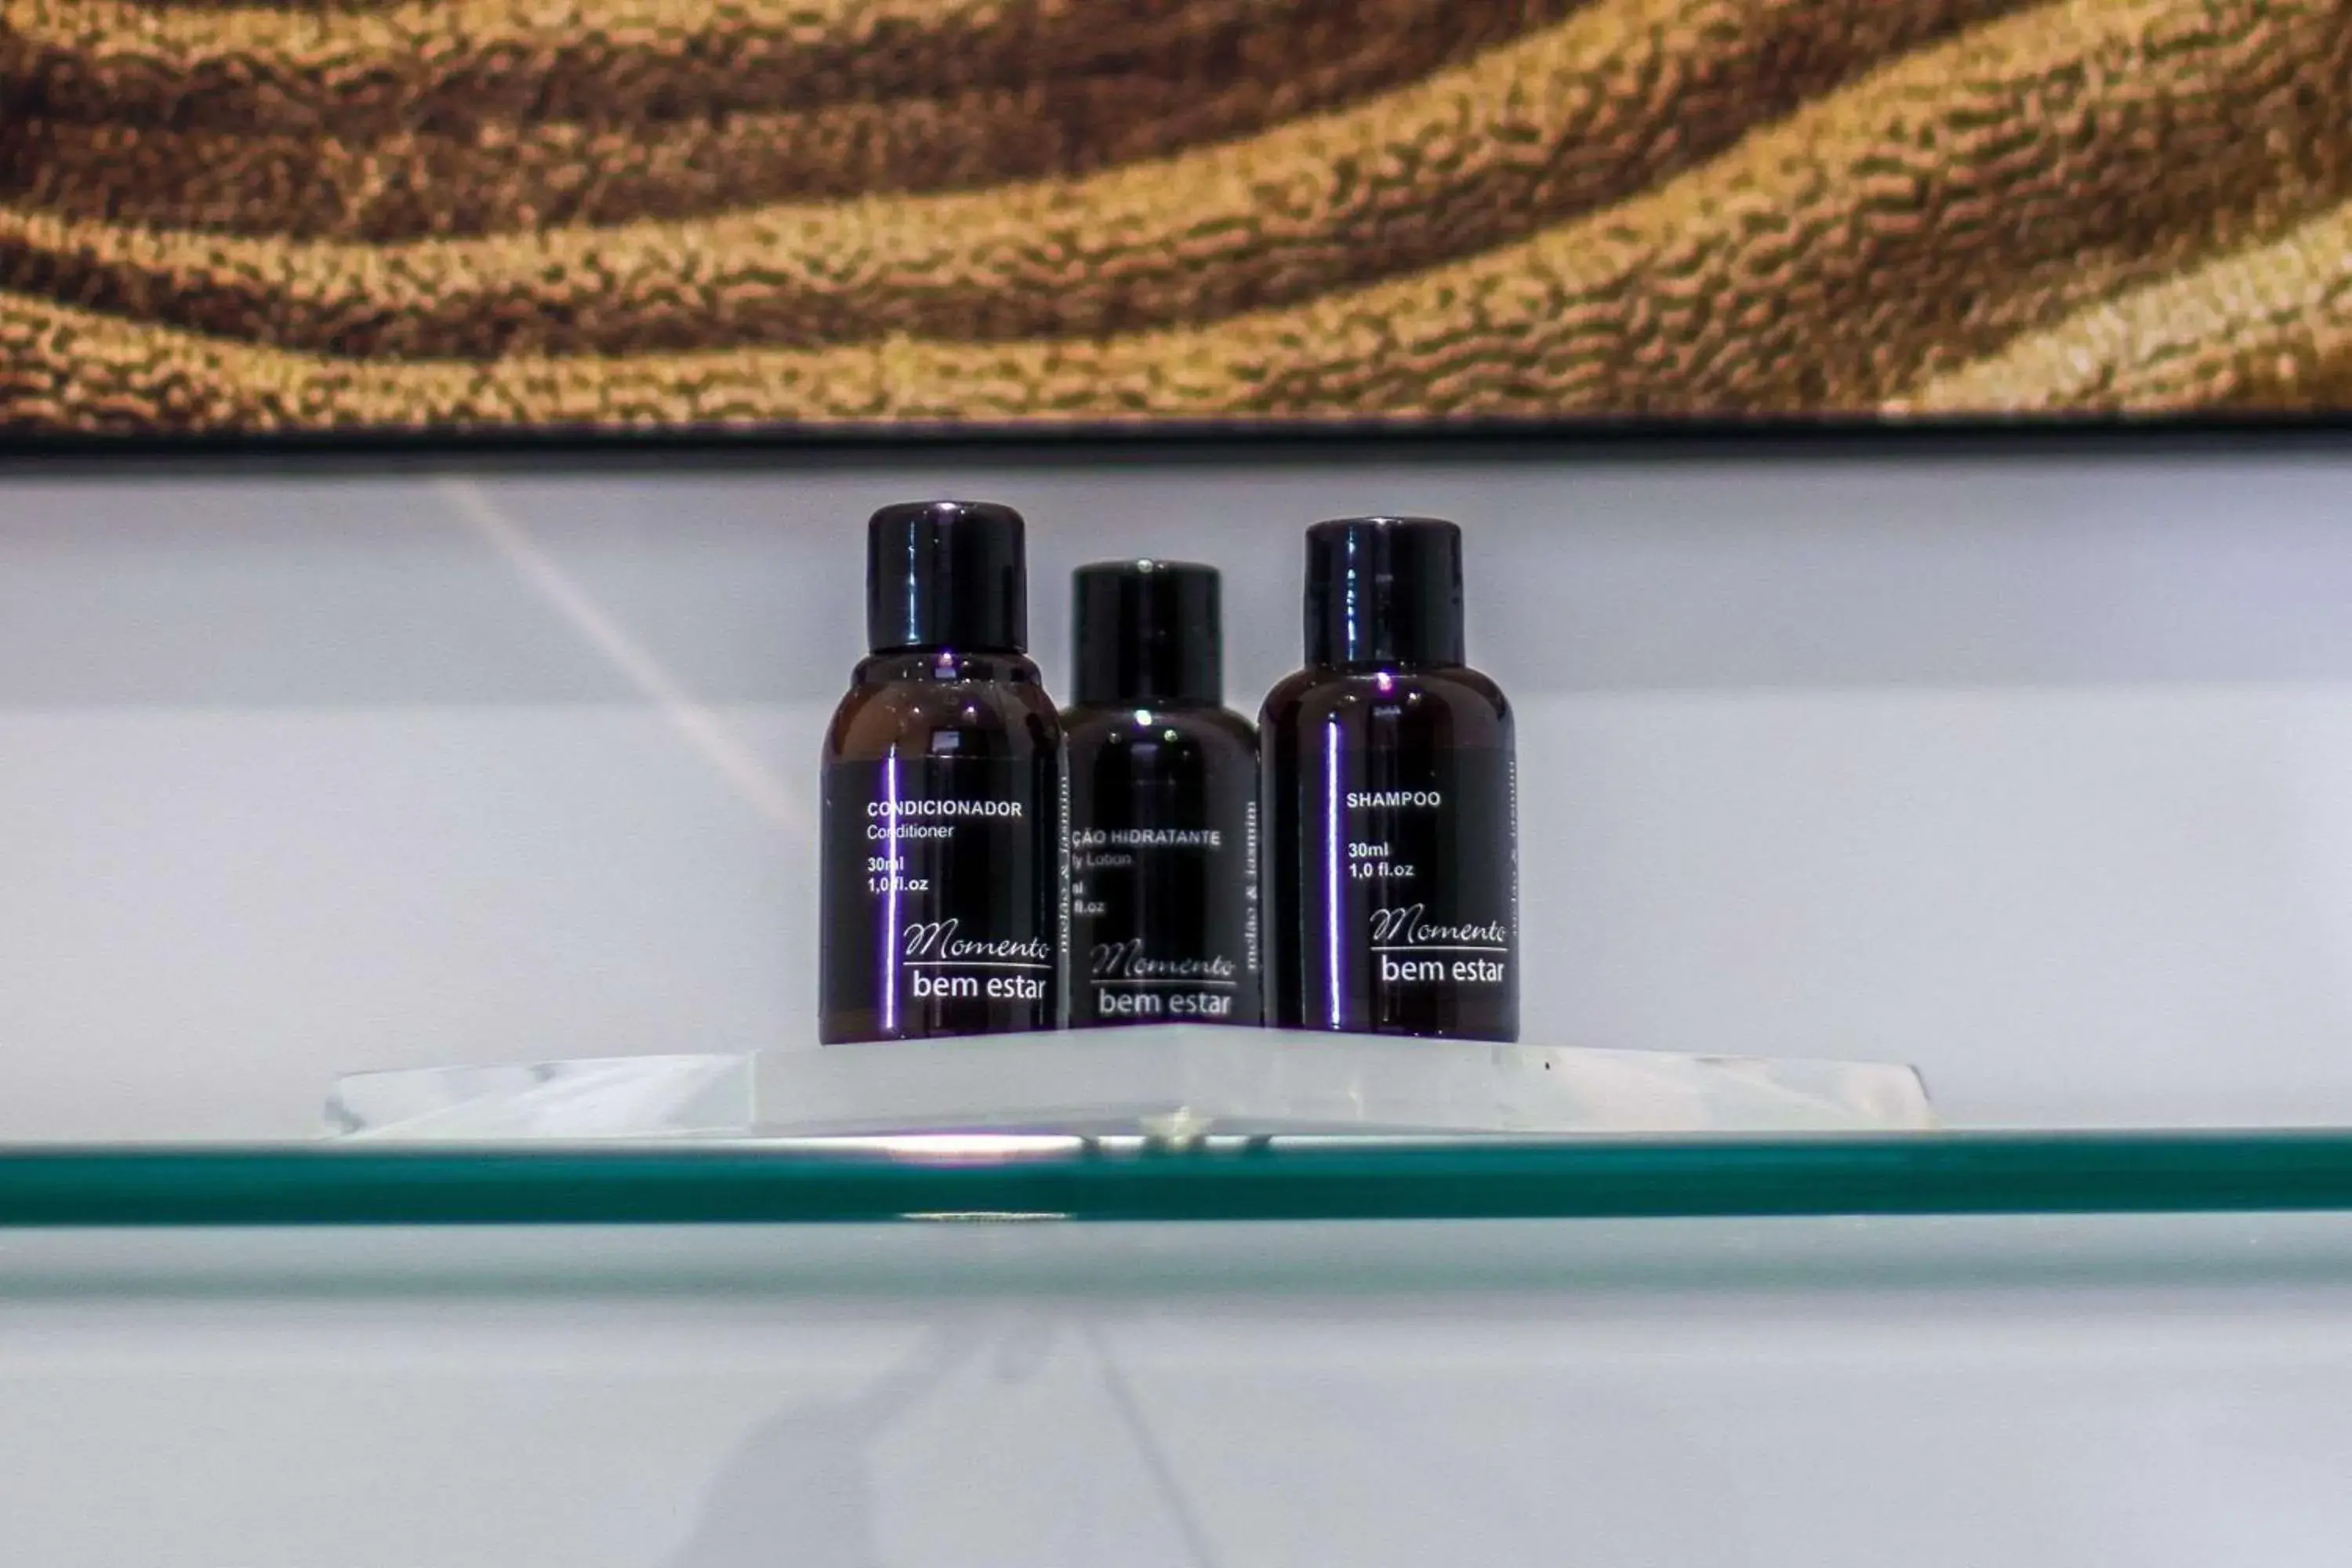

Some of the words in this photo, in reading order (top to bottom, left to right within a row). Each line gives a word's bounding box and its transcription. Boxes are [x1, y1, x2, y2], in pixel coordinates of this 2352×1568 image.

[867, 800, 1022, 817] CONDICIONADOR
[1346, 791, 1441, 808] SHAMPOO
[866, 823, 954, 839] Conditioner
[1072, 827, 1106, 848] ÇÃO
[1111, 829, 1221, 846] HIDRATANTE
[1348, 842, 1389, 858] 30ml
[867, 856, 904, 871] 30ml
[1349, 863, 1373, 879] 1,0
[1378, 862, 1414, 877] fl.oz
[868, 877, 888, 894] 1,0
[1370, 903, 1505, 943] Momento
[903, 918, 1051, 959] Momento
[1091, 938, 1236, 977] Momento
[1382, 954, 1444, 981] bem
[1453, 958, 1504, 982] estar
[913, 970, 978, 996] bem
[987, 975, 1046, 998] estar
[1099, 988, 1160, 1014] bem
[1169, 991, 1231, 1014] estar
